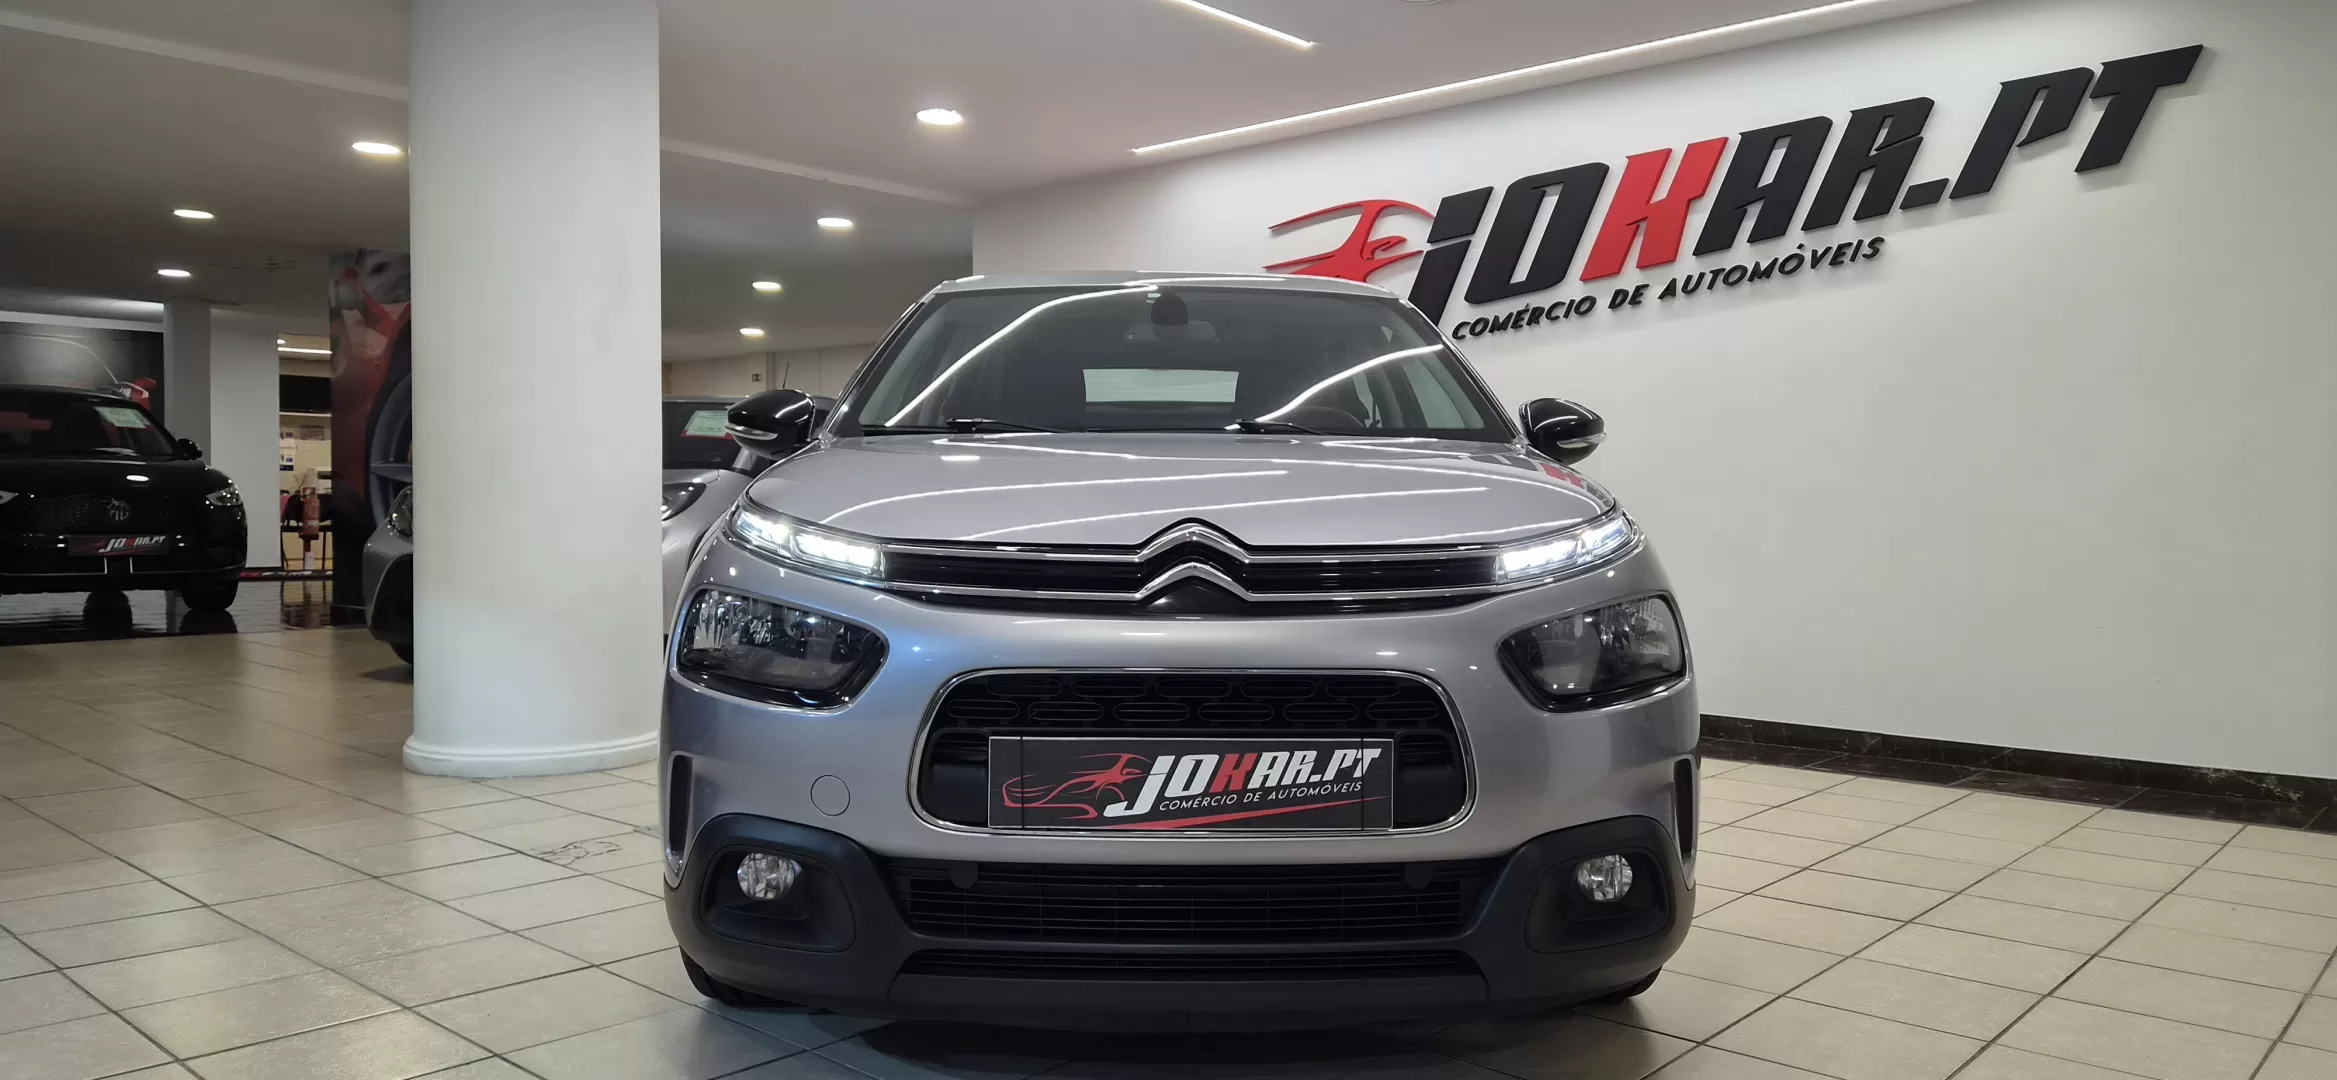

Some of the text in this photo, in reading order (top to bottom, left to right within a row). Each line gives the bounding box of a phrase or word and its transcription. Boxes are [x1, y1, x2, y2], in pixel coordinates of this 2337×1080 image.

[1408, 44, 2203, 327] JOKAR.PT
[1452, 236, 1885, 340] COMÉRCIO DE AUTOMÓVEIS
[1103, 749, 1382, 817] JOKAR.PT
[1159, 781, 1363, 811] COMÉRCIO DE AUTOMÓVEIS
